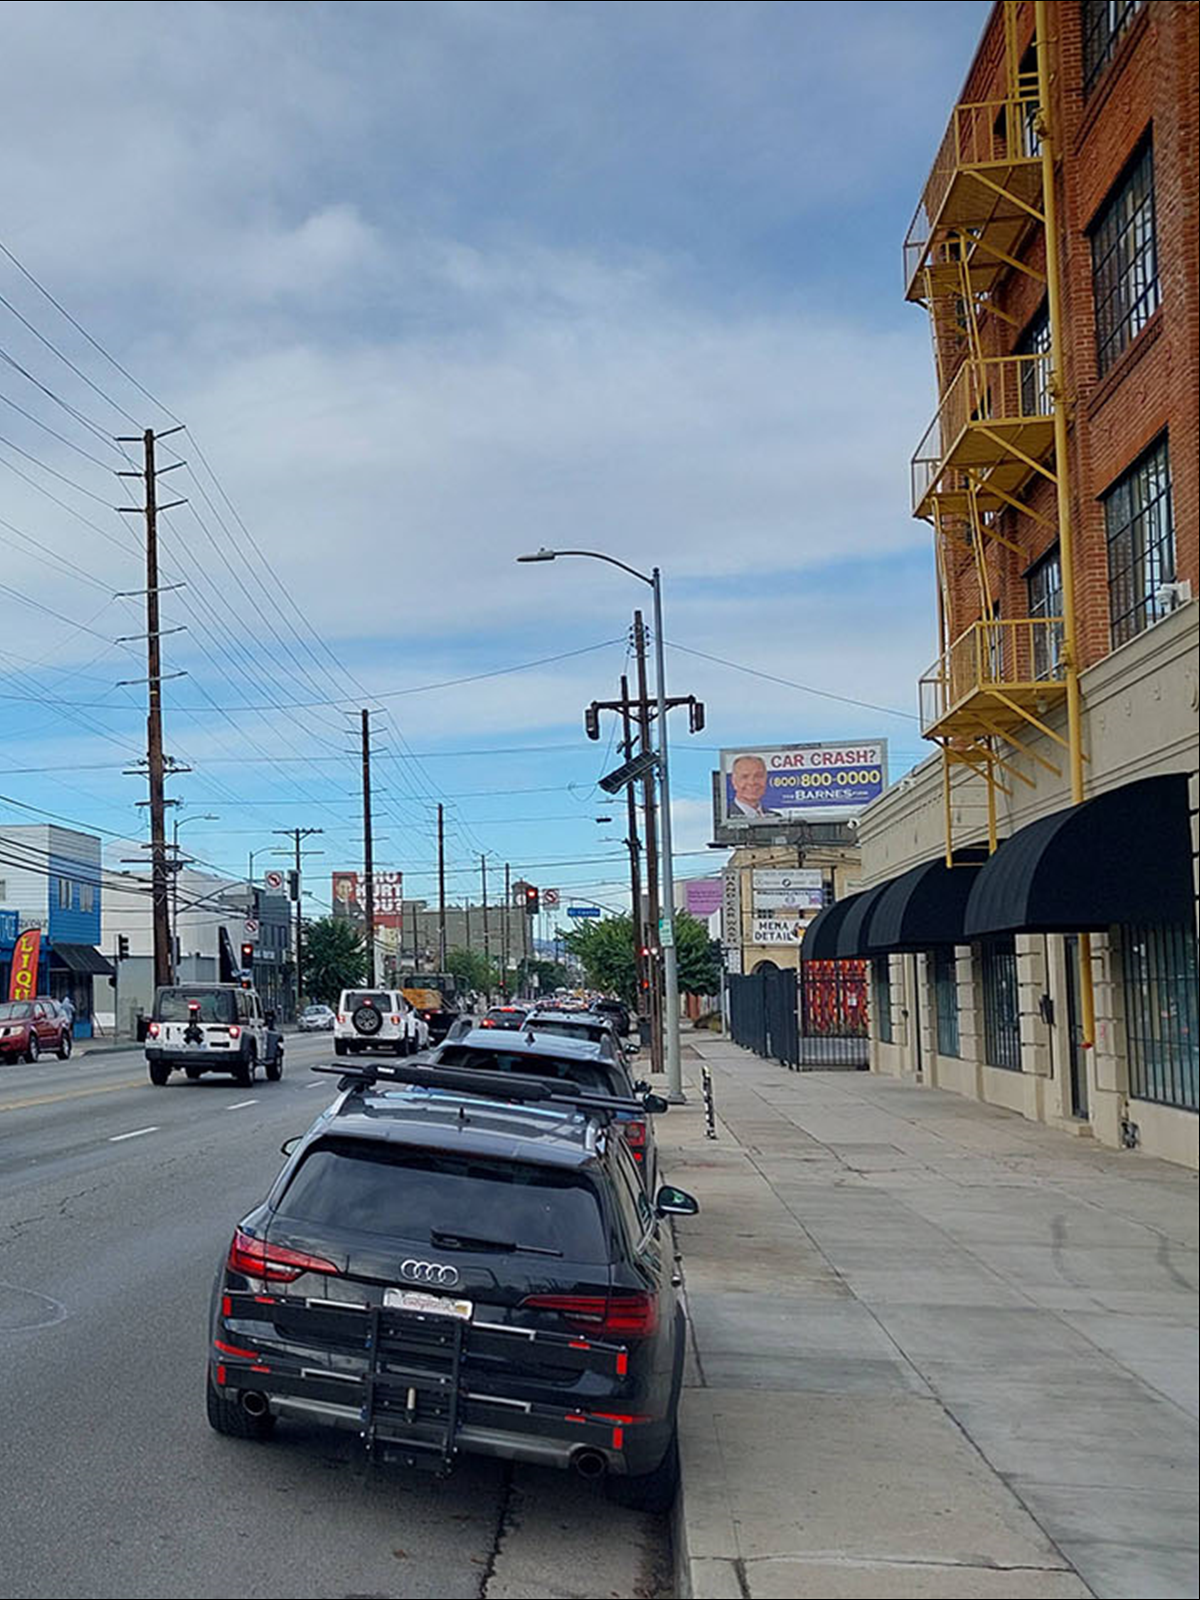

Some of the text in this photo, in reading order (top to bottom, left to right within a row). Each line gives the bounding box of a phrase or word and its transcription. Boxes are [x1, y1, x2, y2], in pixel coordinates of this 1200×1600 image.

[770, 749, 876, 769] CAR CRASH?
[795, 788, 852, 801] BARNES
[725, 875, 737, 899] HAND
[725, 900, 737, 918] CAR
[726, 921, 738, 944] WASH
[759, 921, 789, 931] MENA
